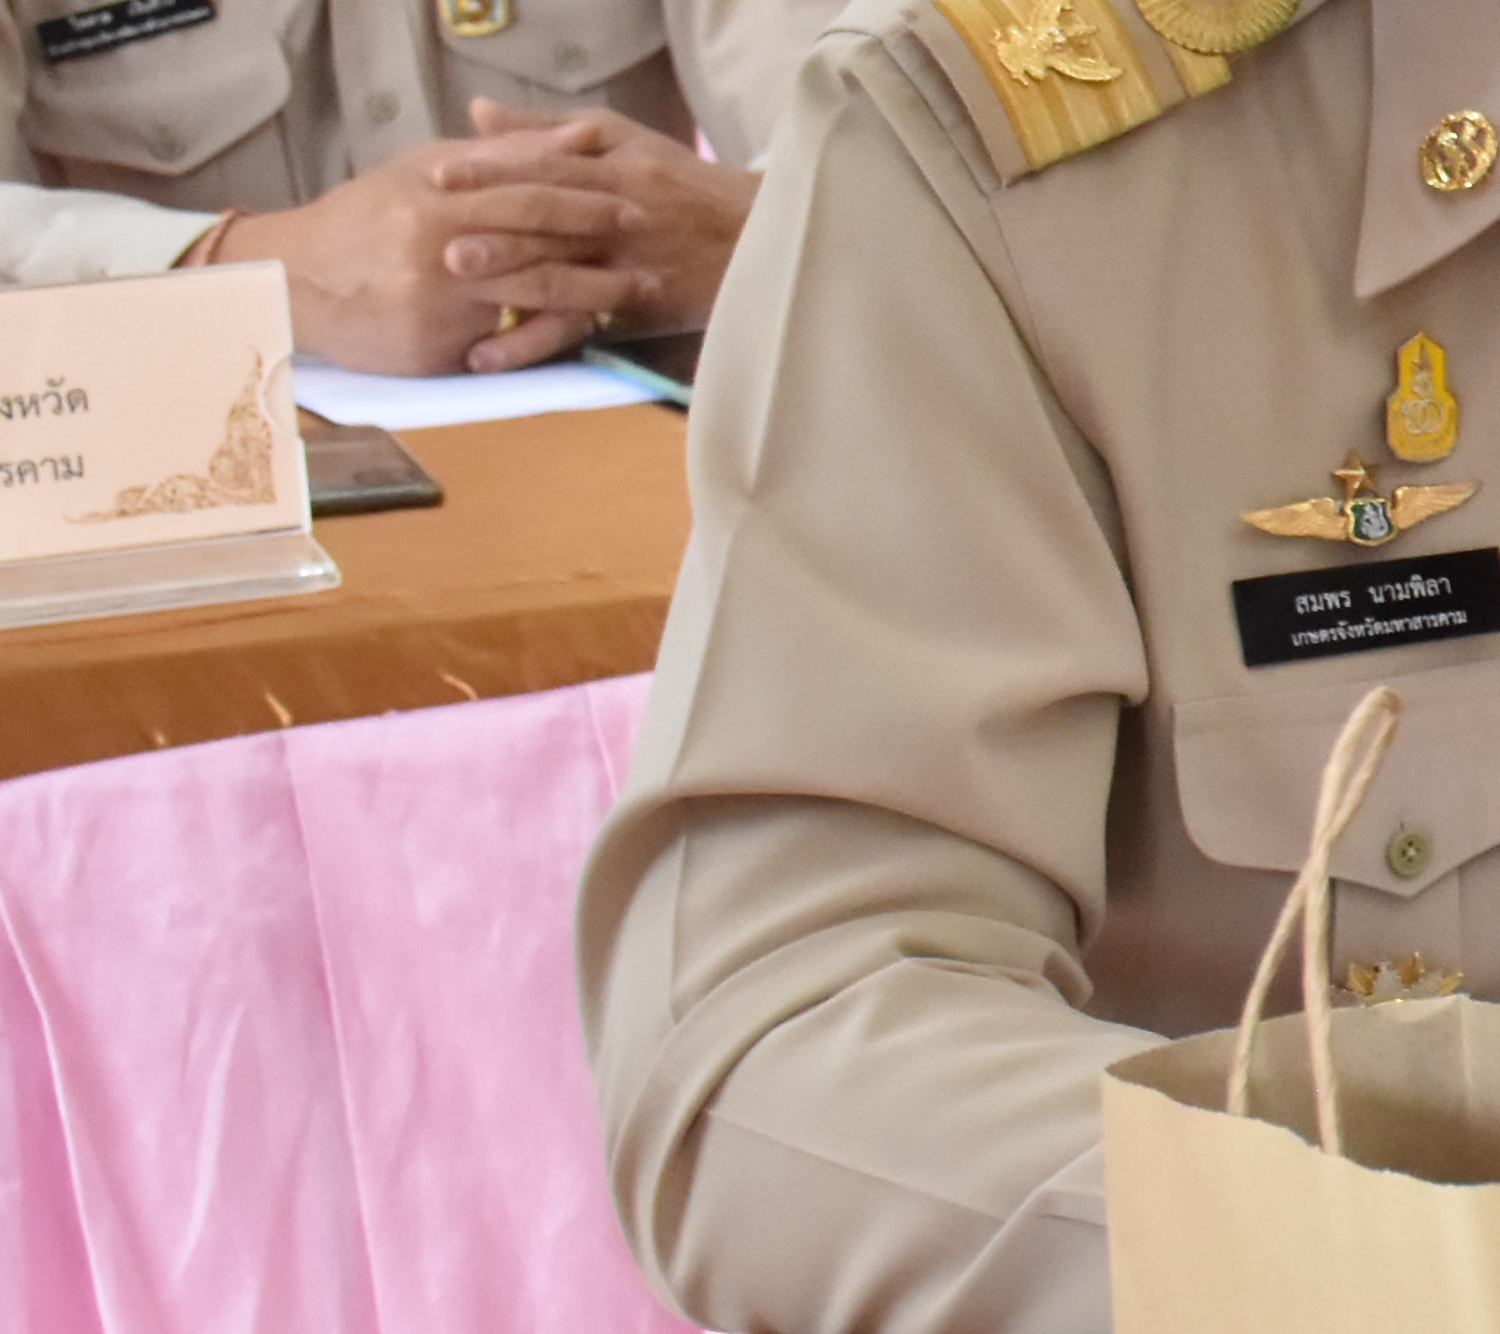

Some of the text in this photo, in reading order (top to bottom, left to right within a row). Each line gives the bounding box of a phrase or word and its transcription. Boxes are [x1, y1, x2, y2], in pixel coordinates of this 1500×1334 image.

[1294, 573, 1453, 615] สมพร นามพิลา
